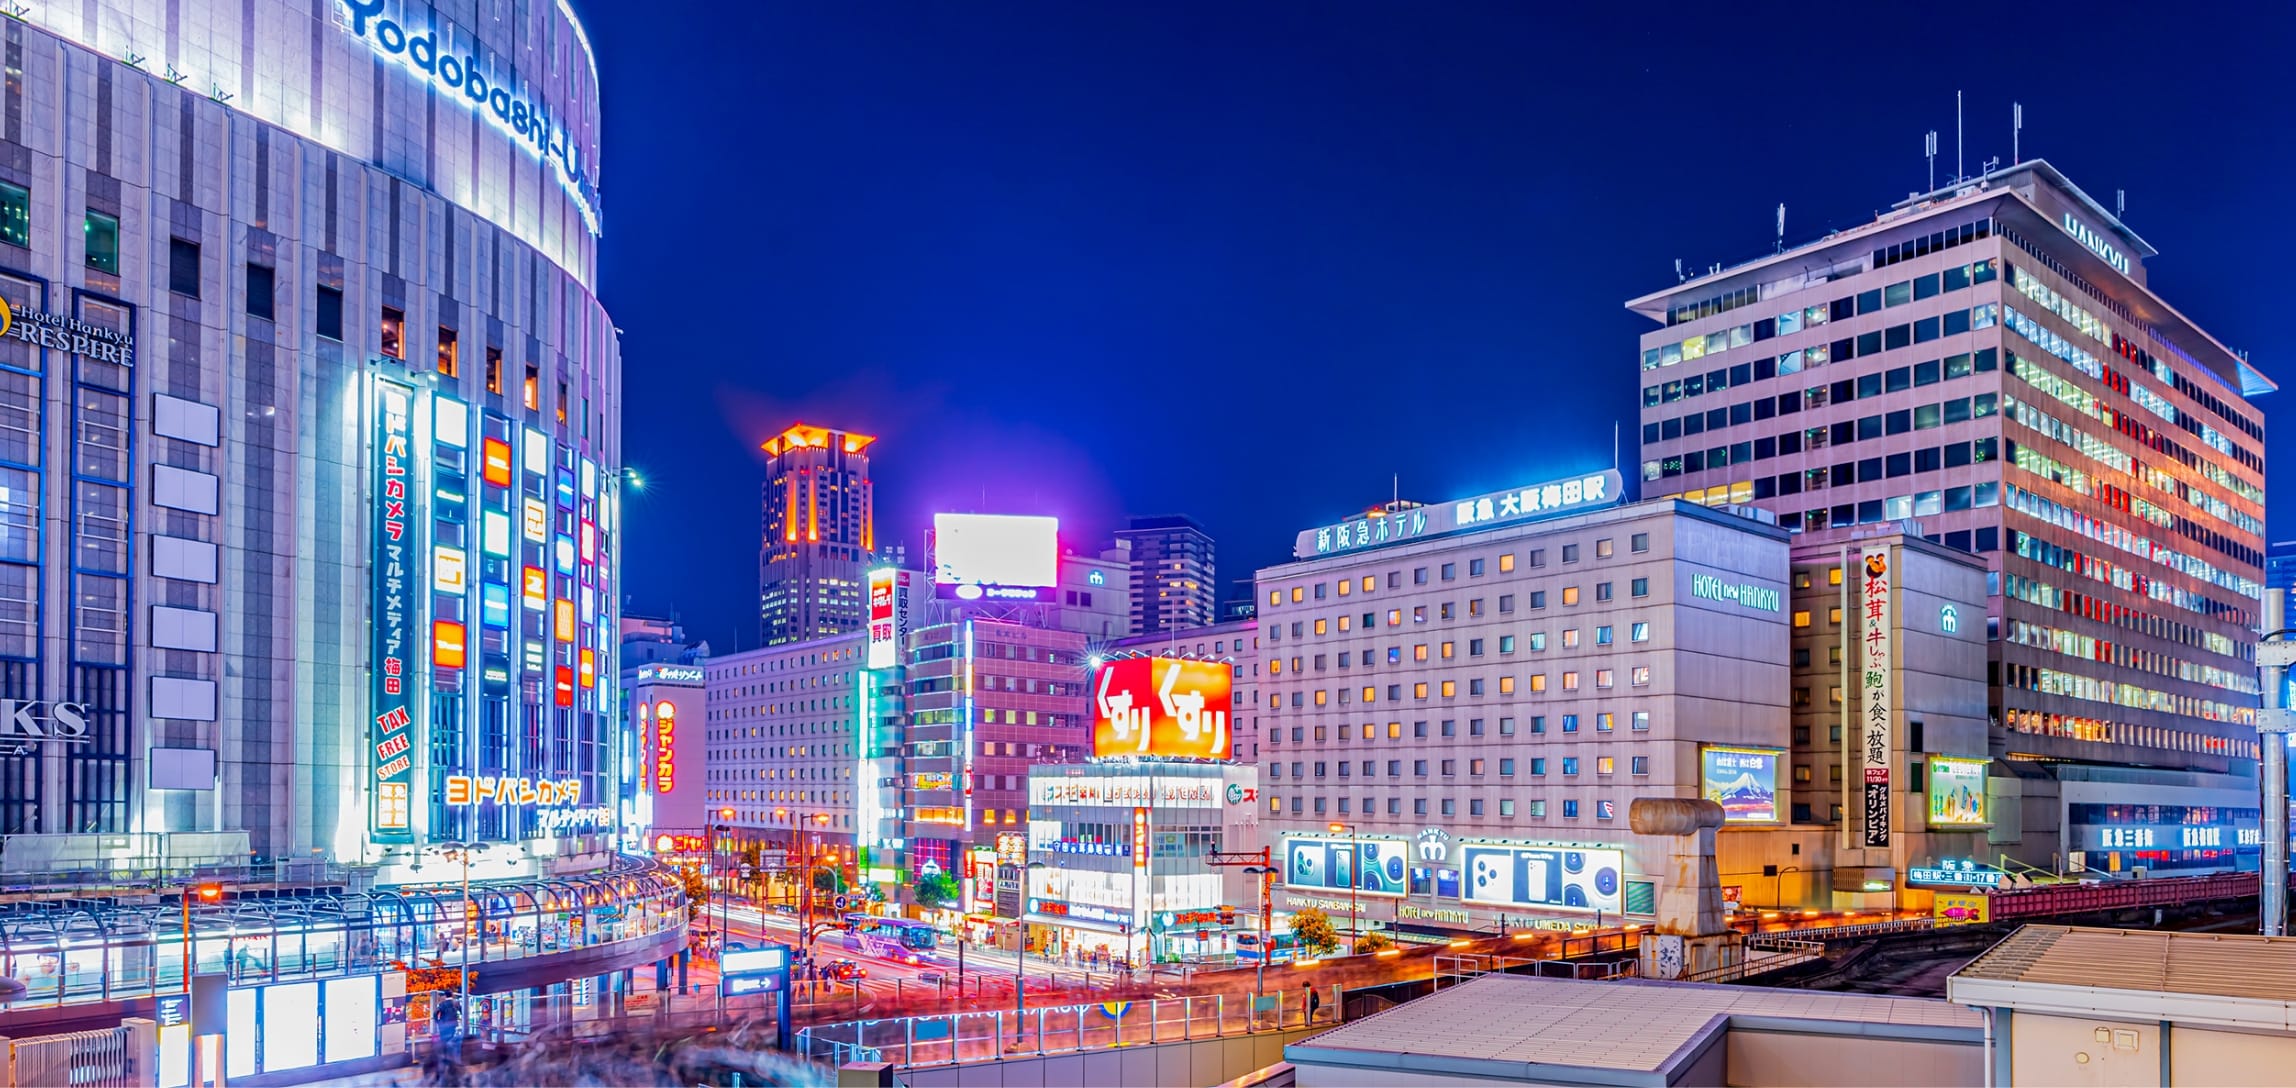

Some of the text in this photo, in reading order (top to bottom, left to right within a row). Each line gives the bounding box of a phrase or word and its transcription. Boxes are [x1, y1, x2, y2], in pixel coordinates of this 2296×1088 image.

[20, 305, 134, 346] Hotel Hankyu
[19, 321, 134, 368] RESPIRE
[1456, 497, 1495, 525] 阪急
[1316, 510, 1427, 553] 新阪急ホテル
[1693, 573, 1779, 612] HOTEL new HANKYU
[376, 704, 411, 735] TAX
[1097, 666, 1151, 752] くすり
[1158, 663, 1226, 754] くすり
[376, 732, 411, 761] FREE
[657, 719, 674, 793] ジャンカラ
[376, 754, 411, 781] STORE
[447, 776, 581, 805] ヨドバシカメラ
[1879, 786, 1888, 842] グルメバイキング
[1416, 827, 1451, 841] HANKYU
[1286, 897, 1318, 907] HANKYU
[1399, 905, 1421, 919] HOTEL
[1534, 919, 1572, 932] UMEDA
